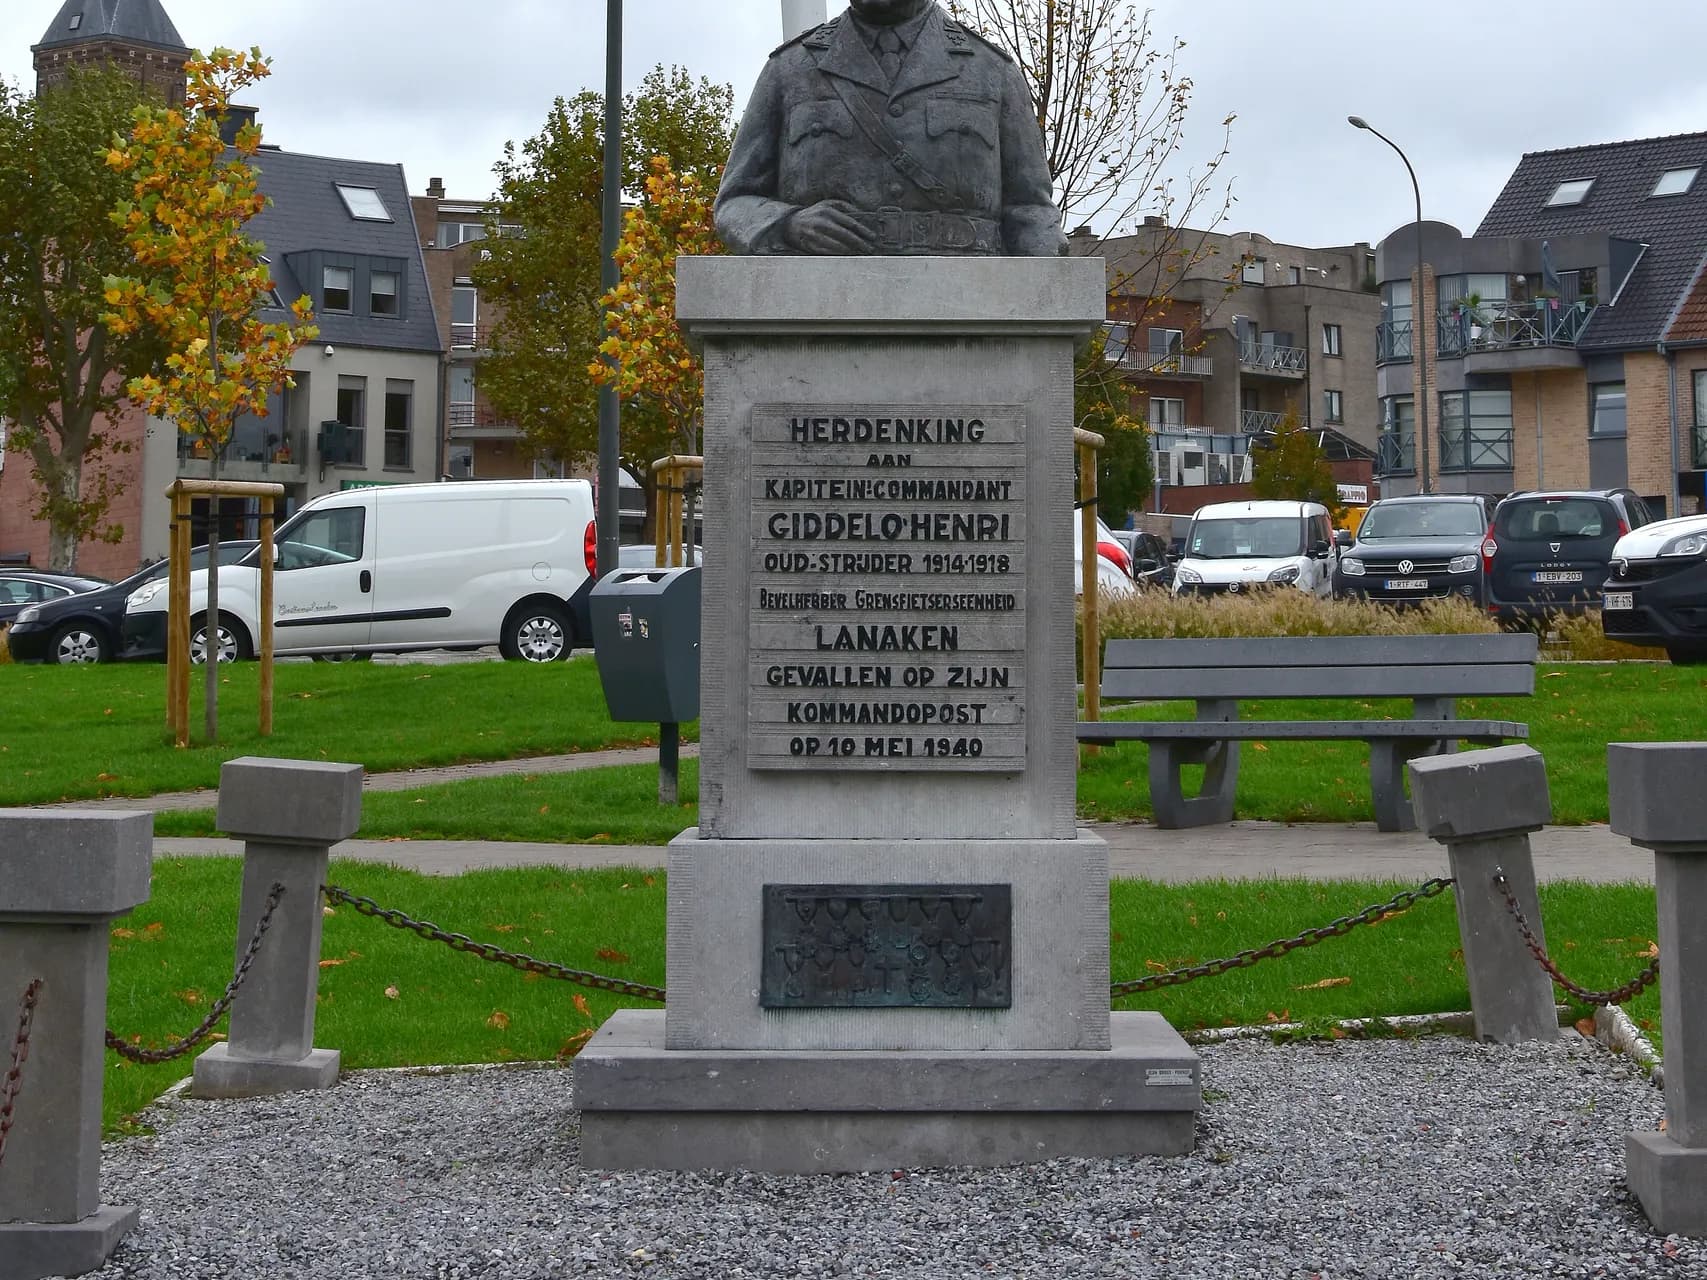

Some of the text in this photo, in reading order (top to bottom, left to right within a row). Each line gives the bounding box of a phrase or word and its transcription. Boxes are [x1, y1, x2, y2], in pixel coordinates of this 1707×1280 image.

[791, 418, 985, 442] HERDENKING
[866, 455, 911, 466] AAN
[815, 625, 958, 650] LANAKEN
[766, 667, 1009, 688] GEVALLEN OP ZIJN
[787, 703, 987, 724] KOMMANDOPOST
[790, 737, 983, 757] OP 10 MEI 1940
